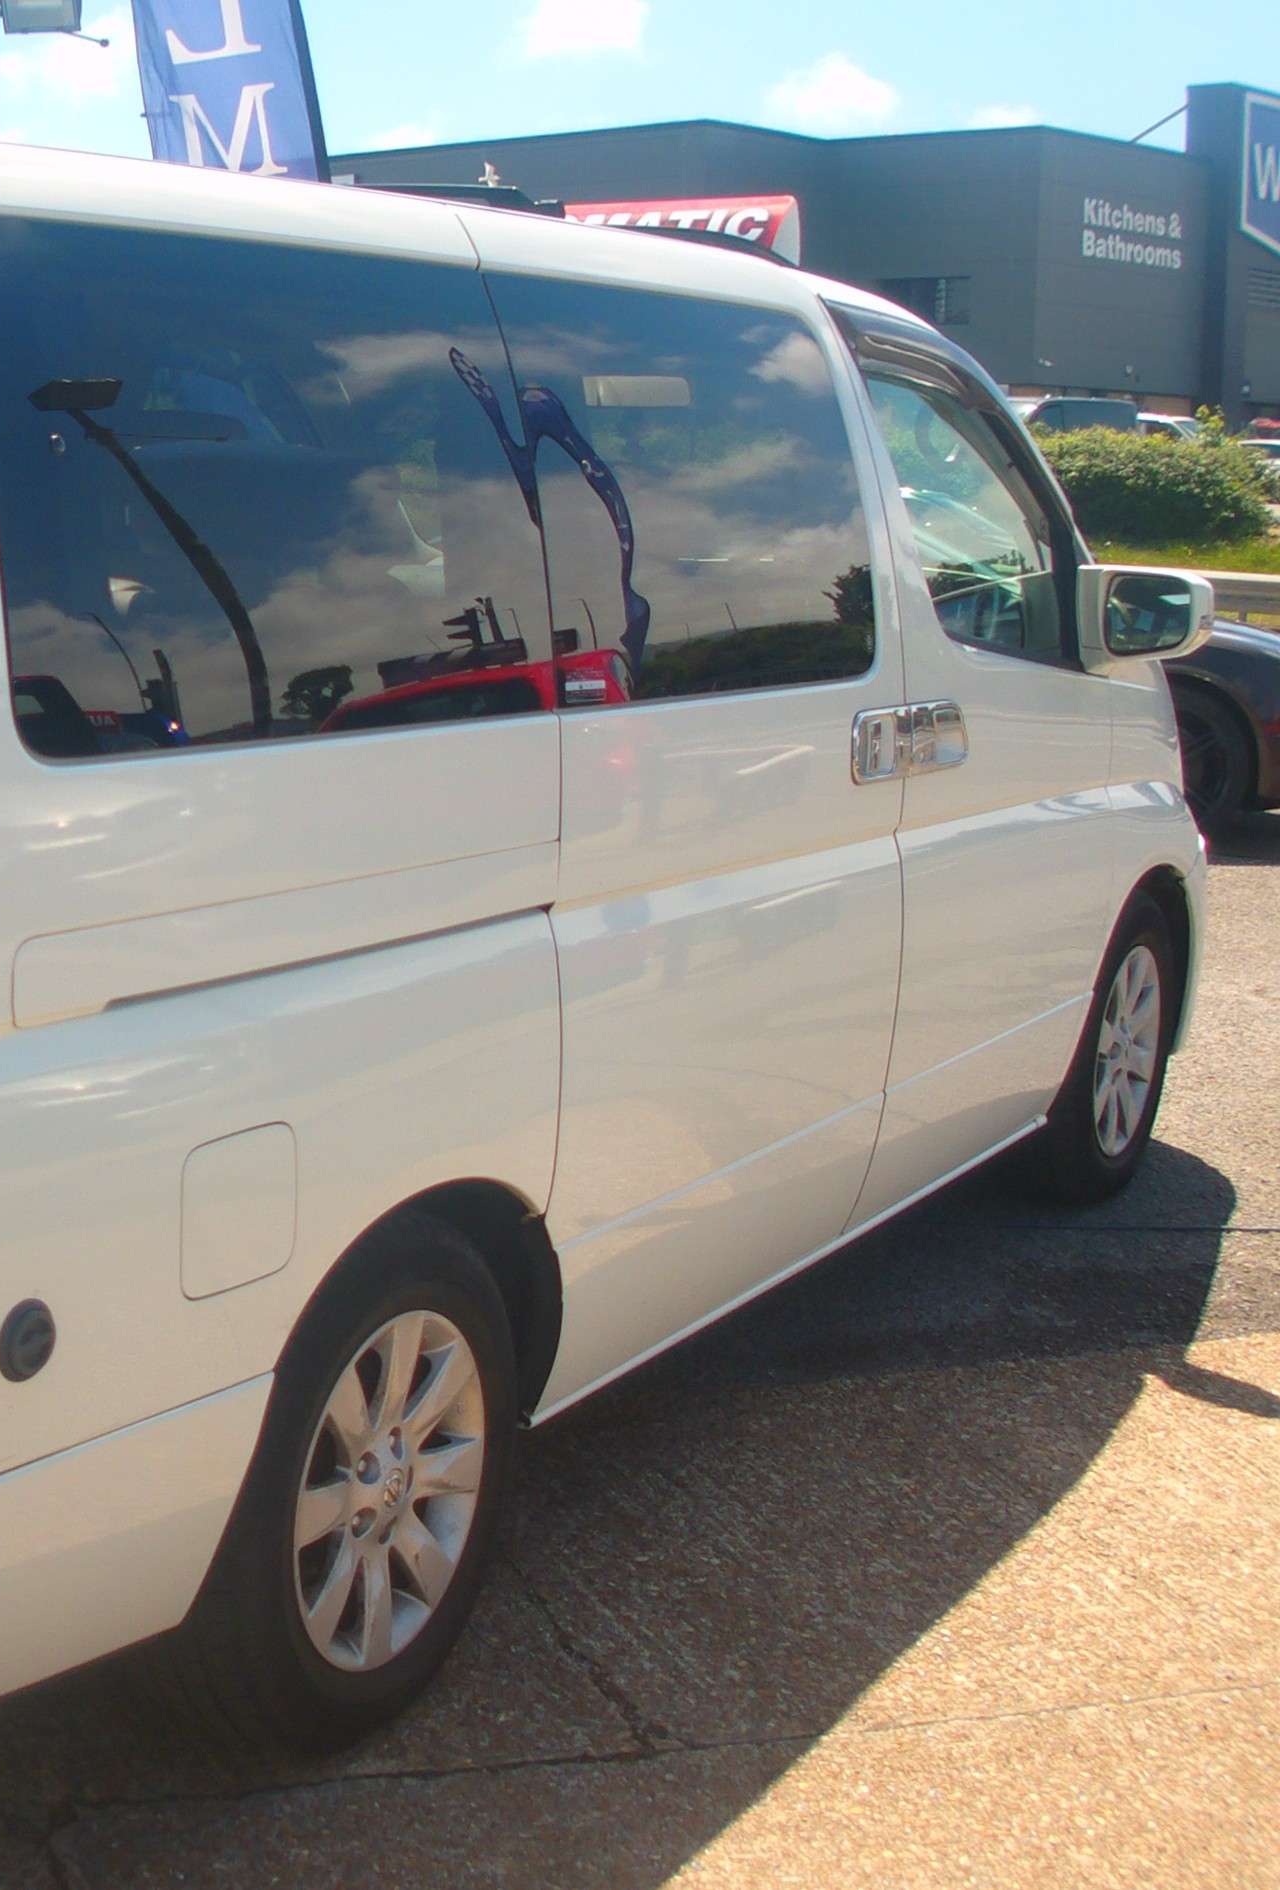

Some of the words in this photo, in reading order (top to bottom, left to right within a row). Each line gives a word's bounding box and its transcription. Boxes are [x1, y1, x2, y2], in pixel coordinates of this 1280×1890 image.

[1083, 197, 1166, 236] Kitchens
[1168, 212, 1182, 239] &
[1082, 229, 1182, 269] Bathrooms
